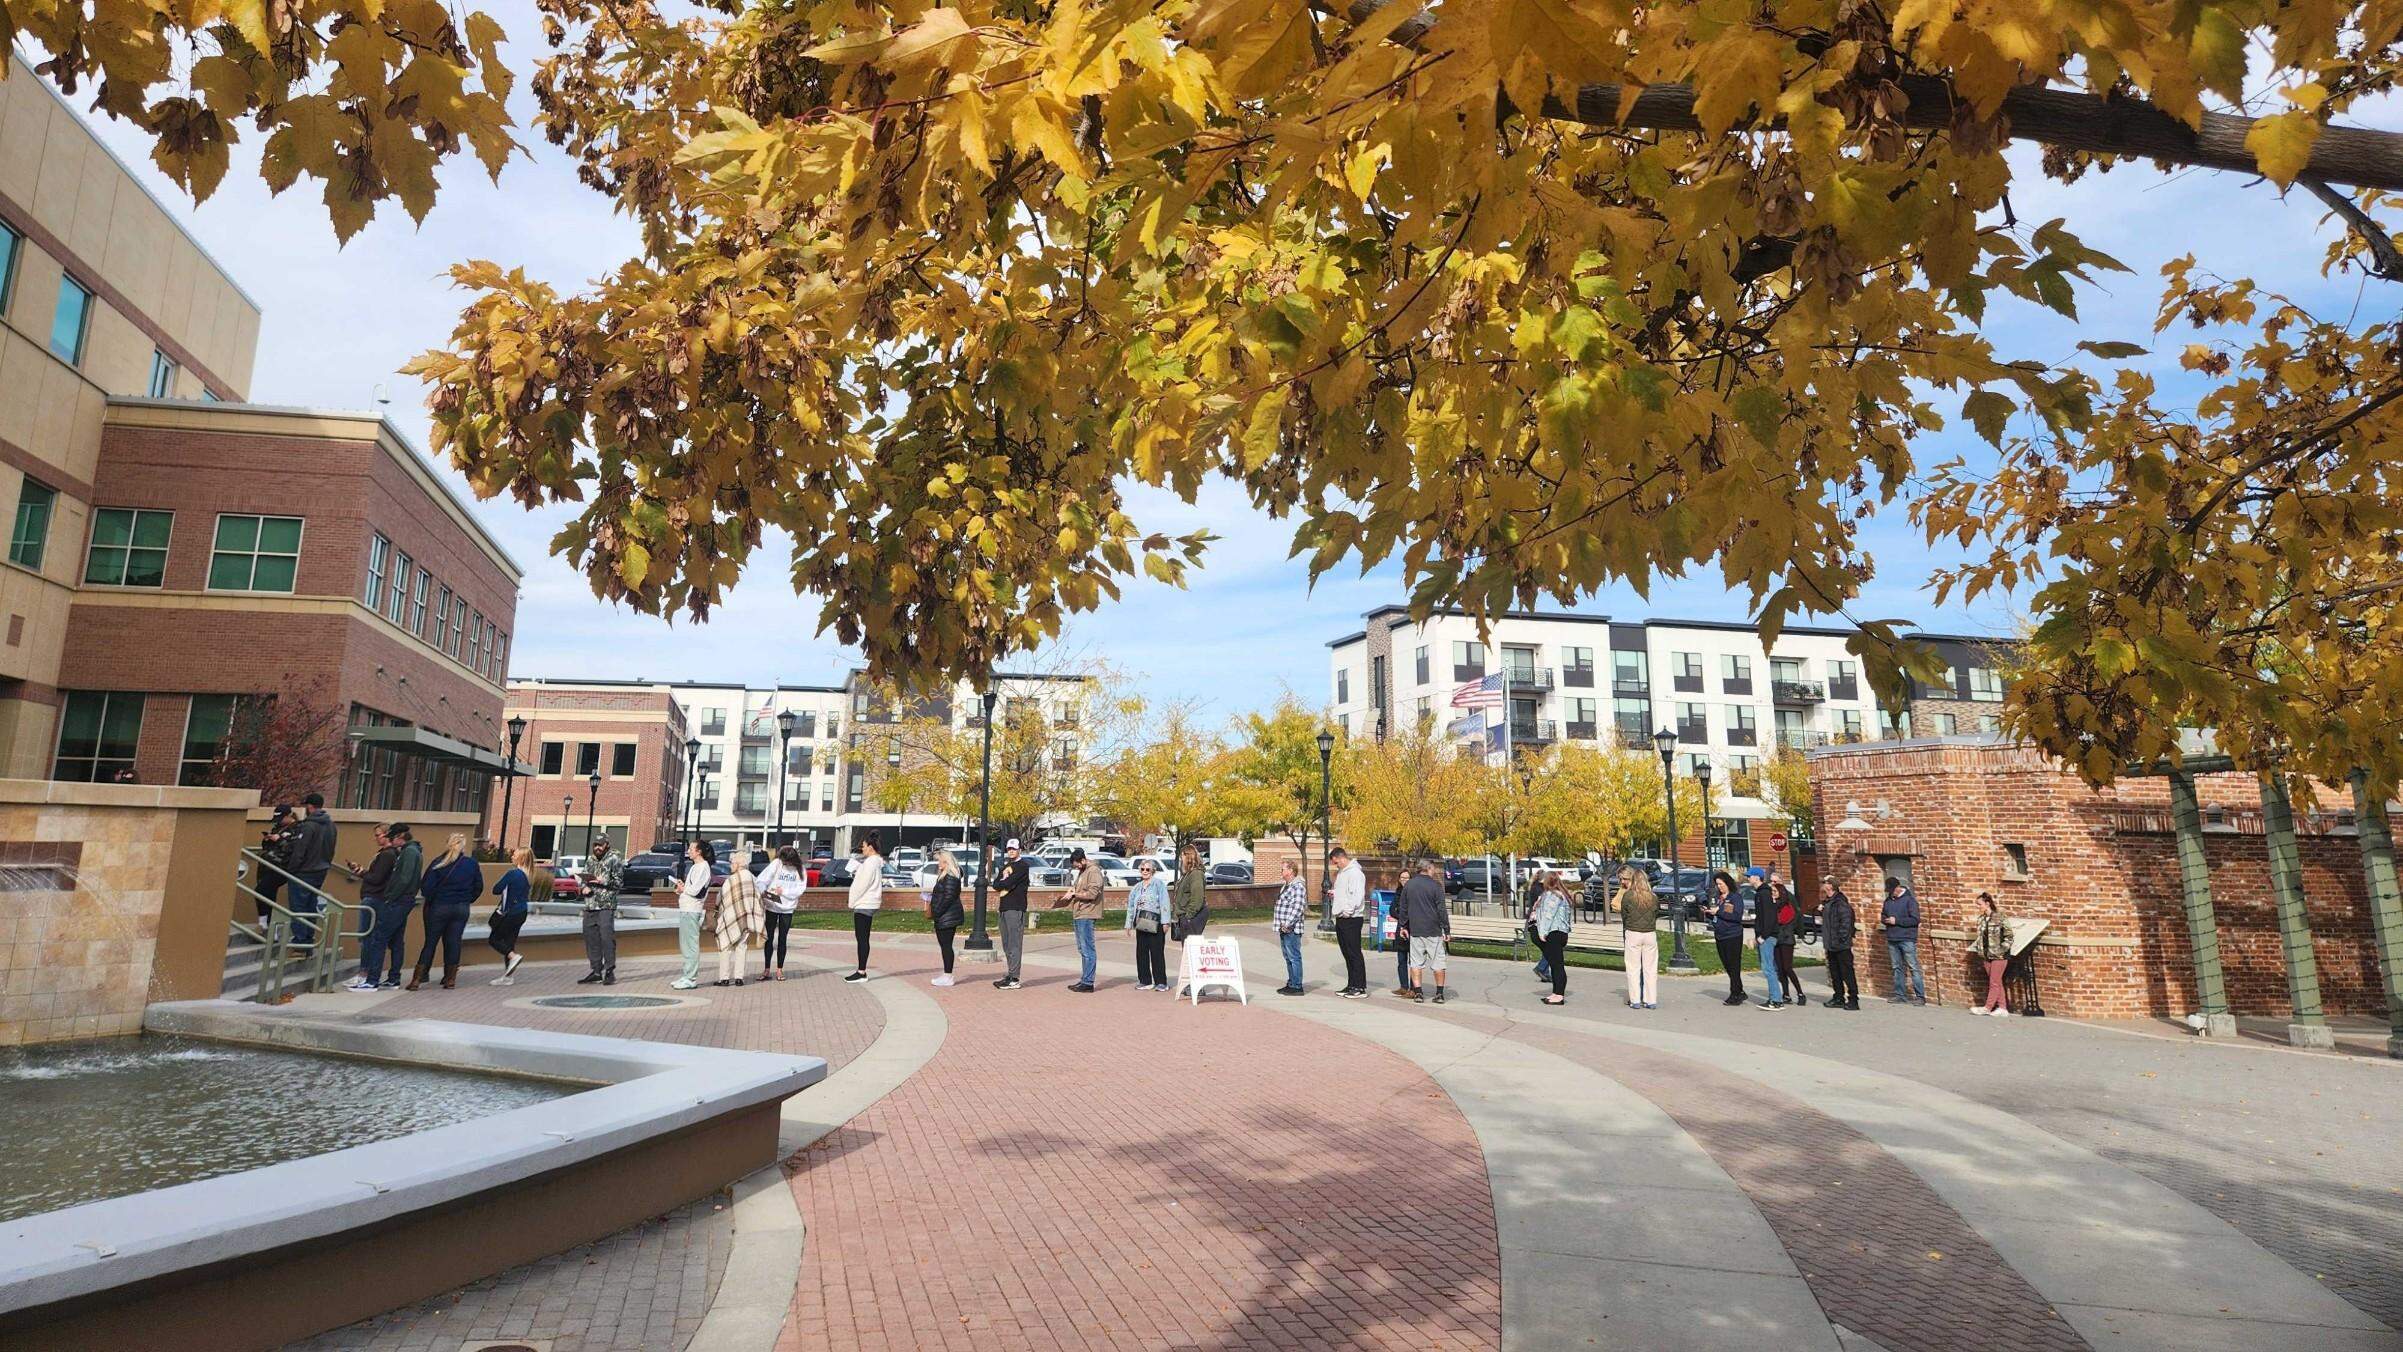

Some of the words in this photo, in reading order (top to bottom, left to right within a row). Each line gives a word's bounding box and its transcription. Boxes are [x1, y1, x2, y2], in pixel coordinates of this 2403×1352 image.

[1770, 838, 1785, 846] STOP
[1200, 946, 1225, 955] EARLY
[1200, 957, 1230, 966] VOTING
